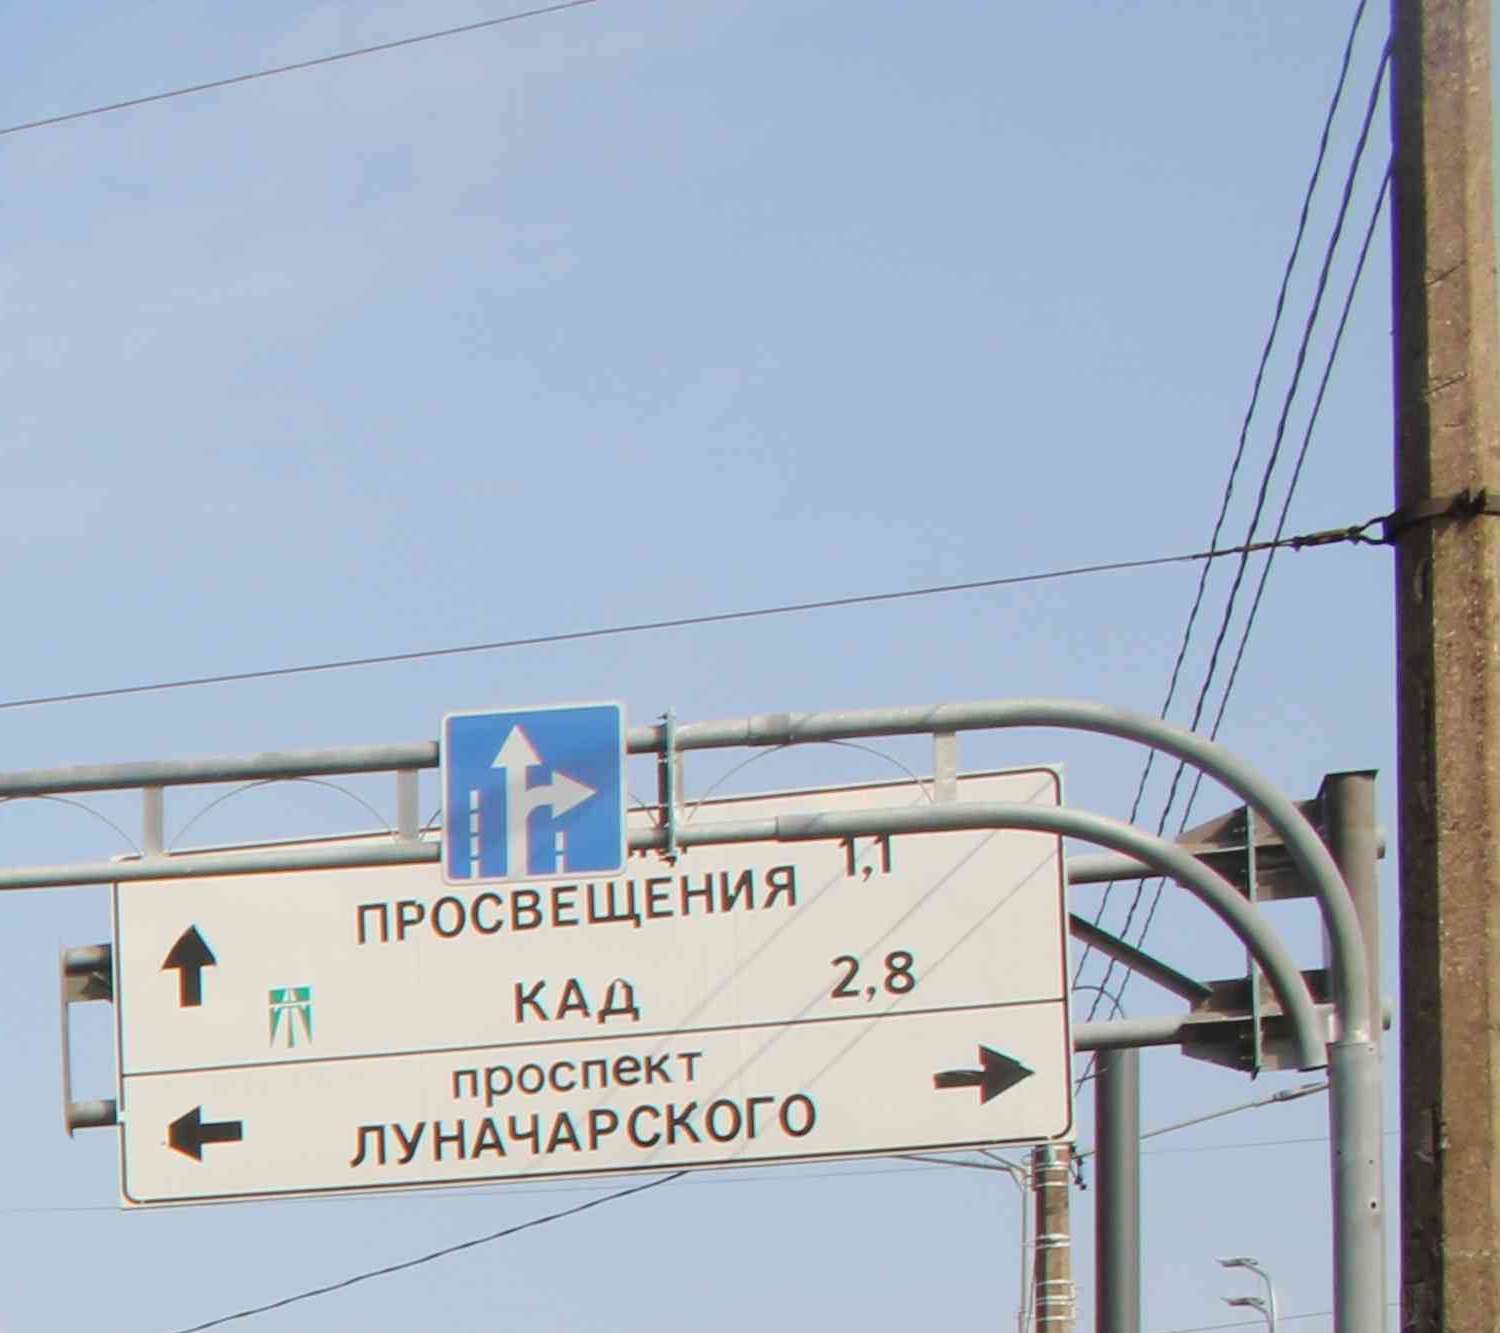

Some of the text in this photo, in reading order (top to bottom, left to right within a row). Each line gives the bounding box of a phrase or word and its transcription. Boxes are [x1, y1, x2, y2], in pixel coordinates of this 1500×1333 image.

[357, 865, 797, 944] ПРОСВЕЩЕНИЯ
[513, 950, 916, 1024] КАД 2,8
[452, 1050, 702, 1107] проспект
[350, 1093, 817, 1168] ЛУНАЧАРСКОГО
